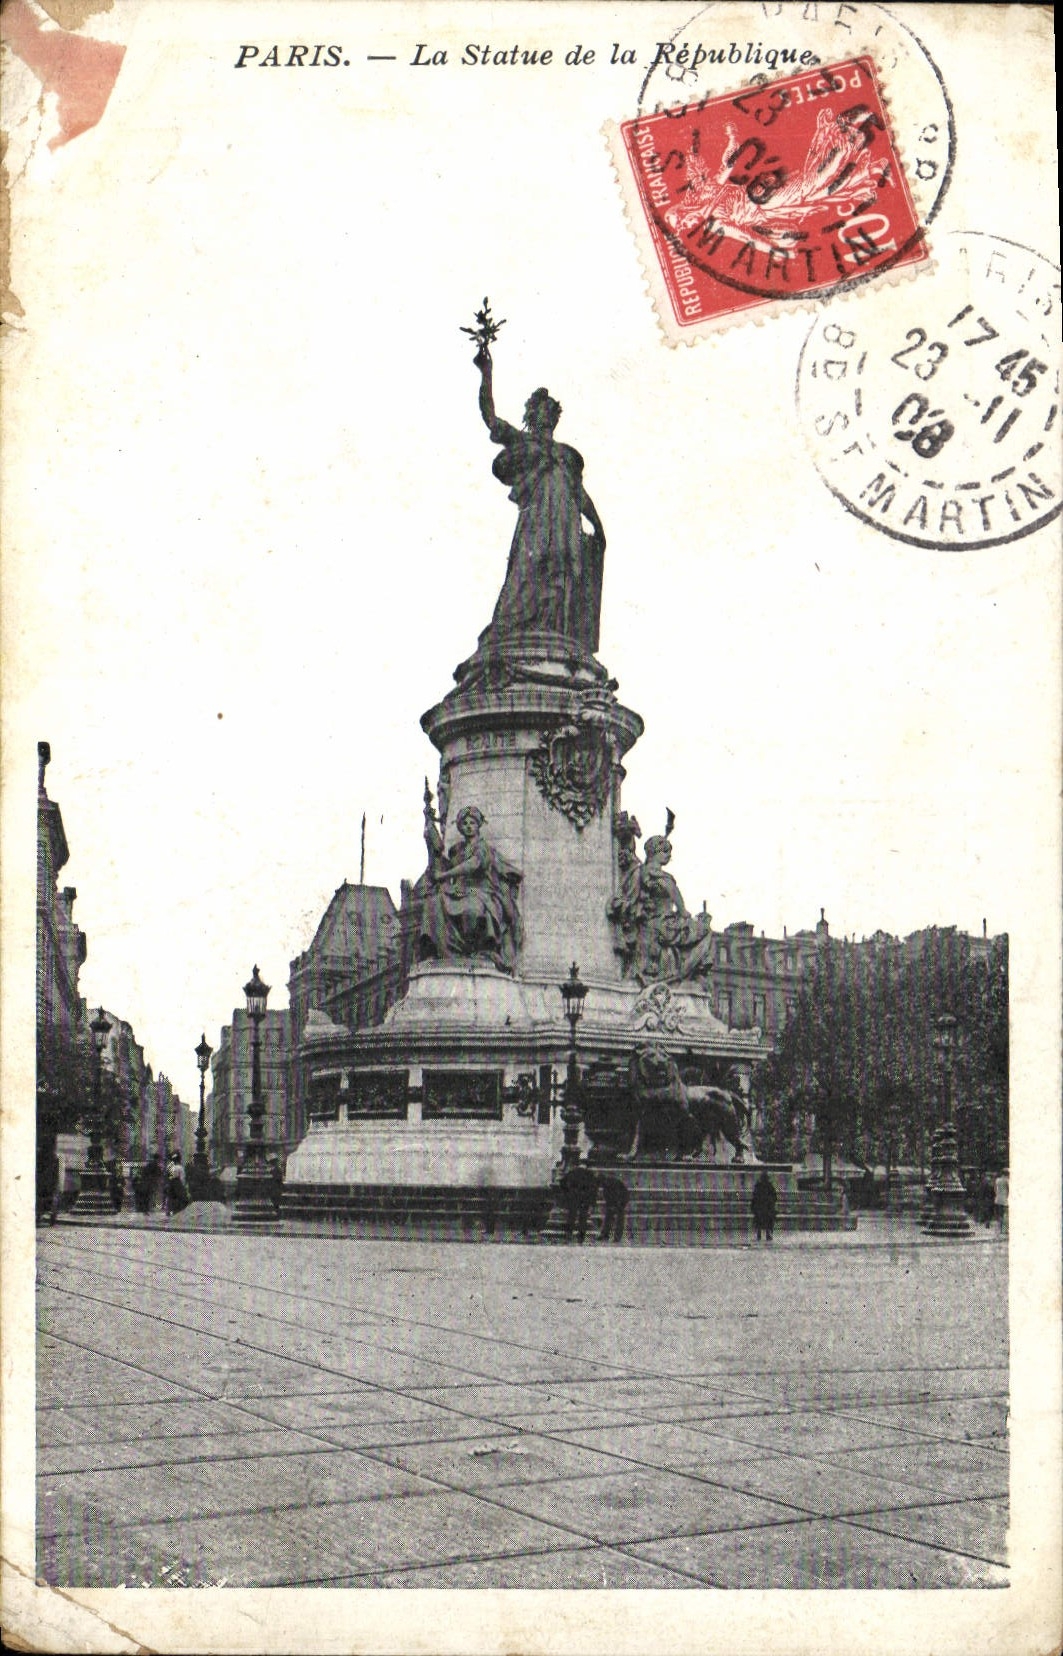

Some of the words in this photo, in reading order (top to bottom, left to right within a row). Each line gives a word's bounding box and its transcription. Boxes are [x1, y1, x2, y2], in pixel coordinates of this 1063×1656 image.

[686, 214, 881, 283] MARTIN
[890, 327, 949, 381] 23
[947, 304, 1000, 347] 17
[995, 349, 1049, 398] 45
[859, 472, 1055, 535] MARTIN
